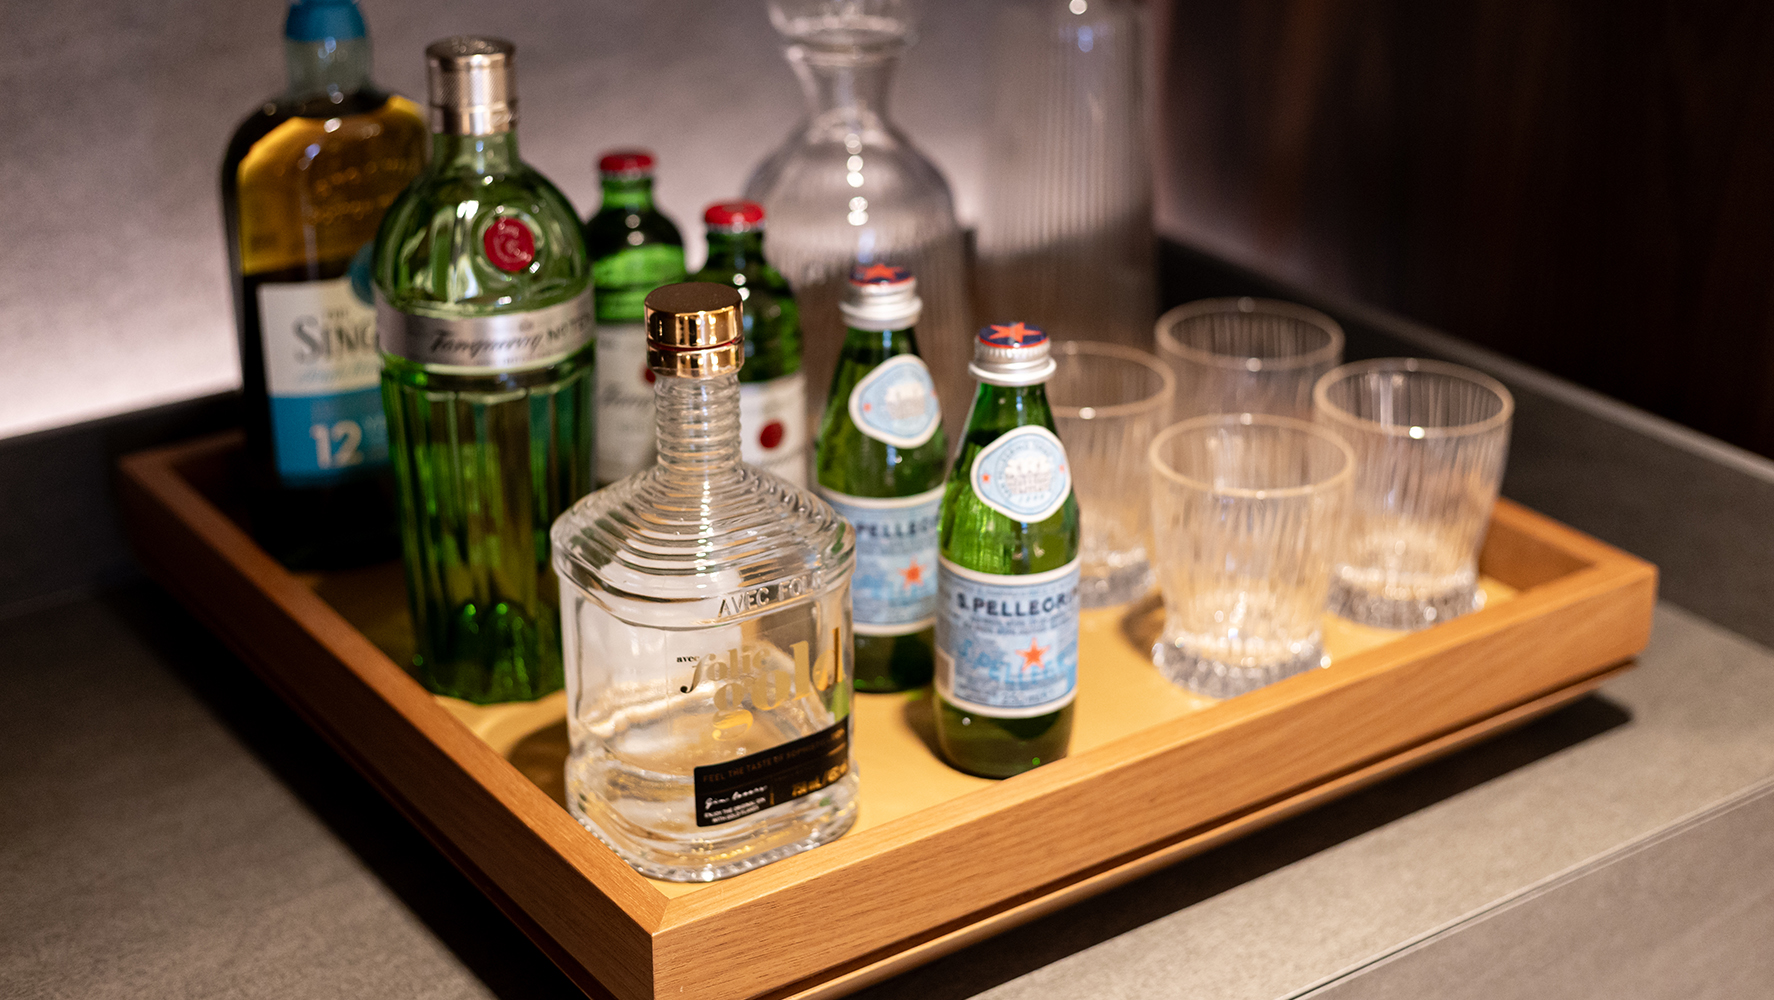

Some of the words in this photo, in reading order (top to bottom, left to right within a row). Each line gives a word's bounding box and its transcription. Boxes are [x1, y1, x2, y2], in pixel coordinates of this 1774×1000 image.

[431, 326, 542, 359] Tanqueray
[309, 418, 363, 470] 12
[718, 587, 770, 618] AVEC
[676, 655, 700, 663] avec
[680, 645, 771, 693] folie
[711, 627, 844, 742] gold
[703, 774, 726, 783] FEEL
[728, 767, 745, 778] THE
[746, 757, 772, 772] TASTE
